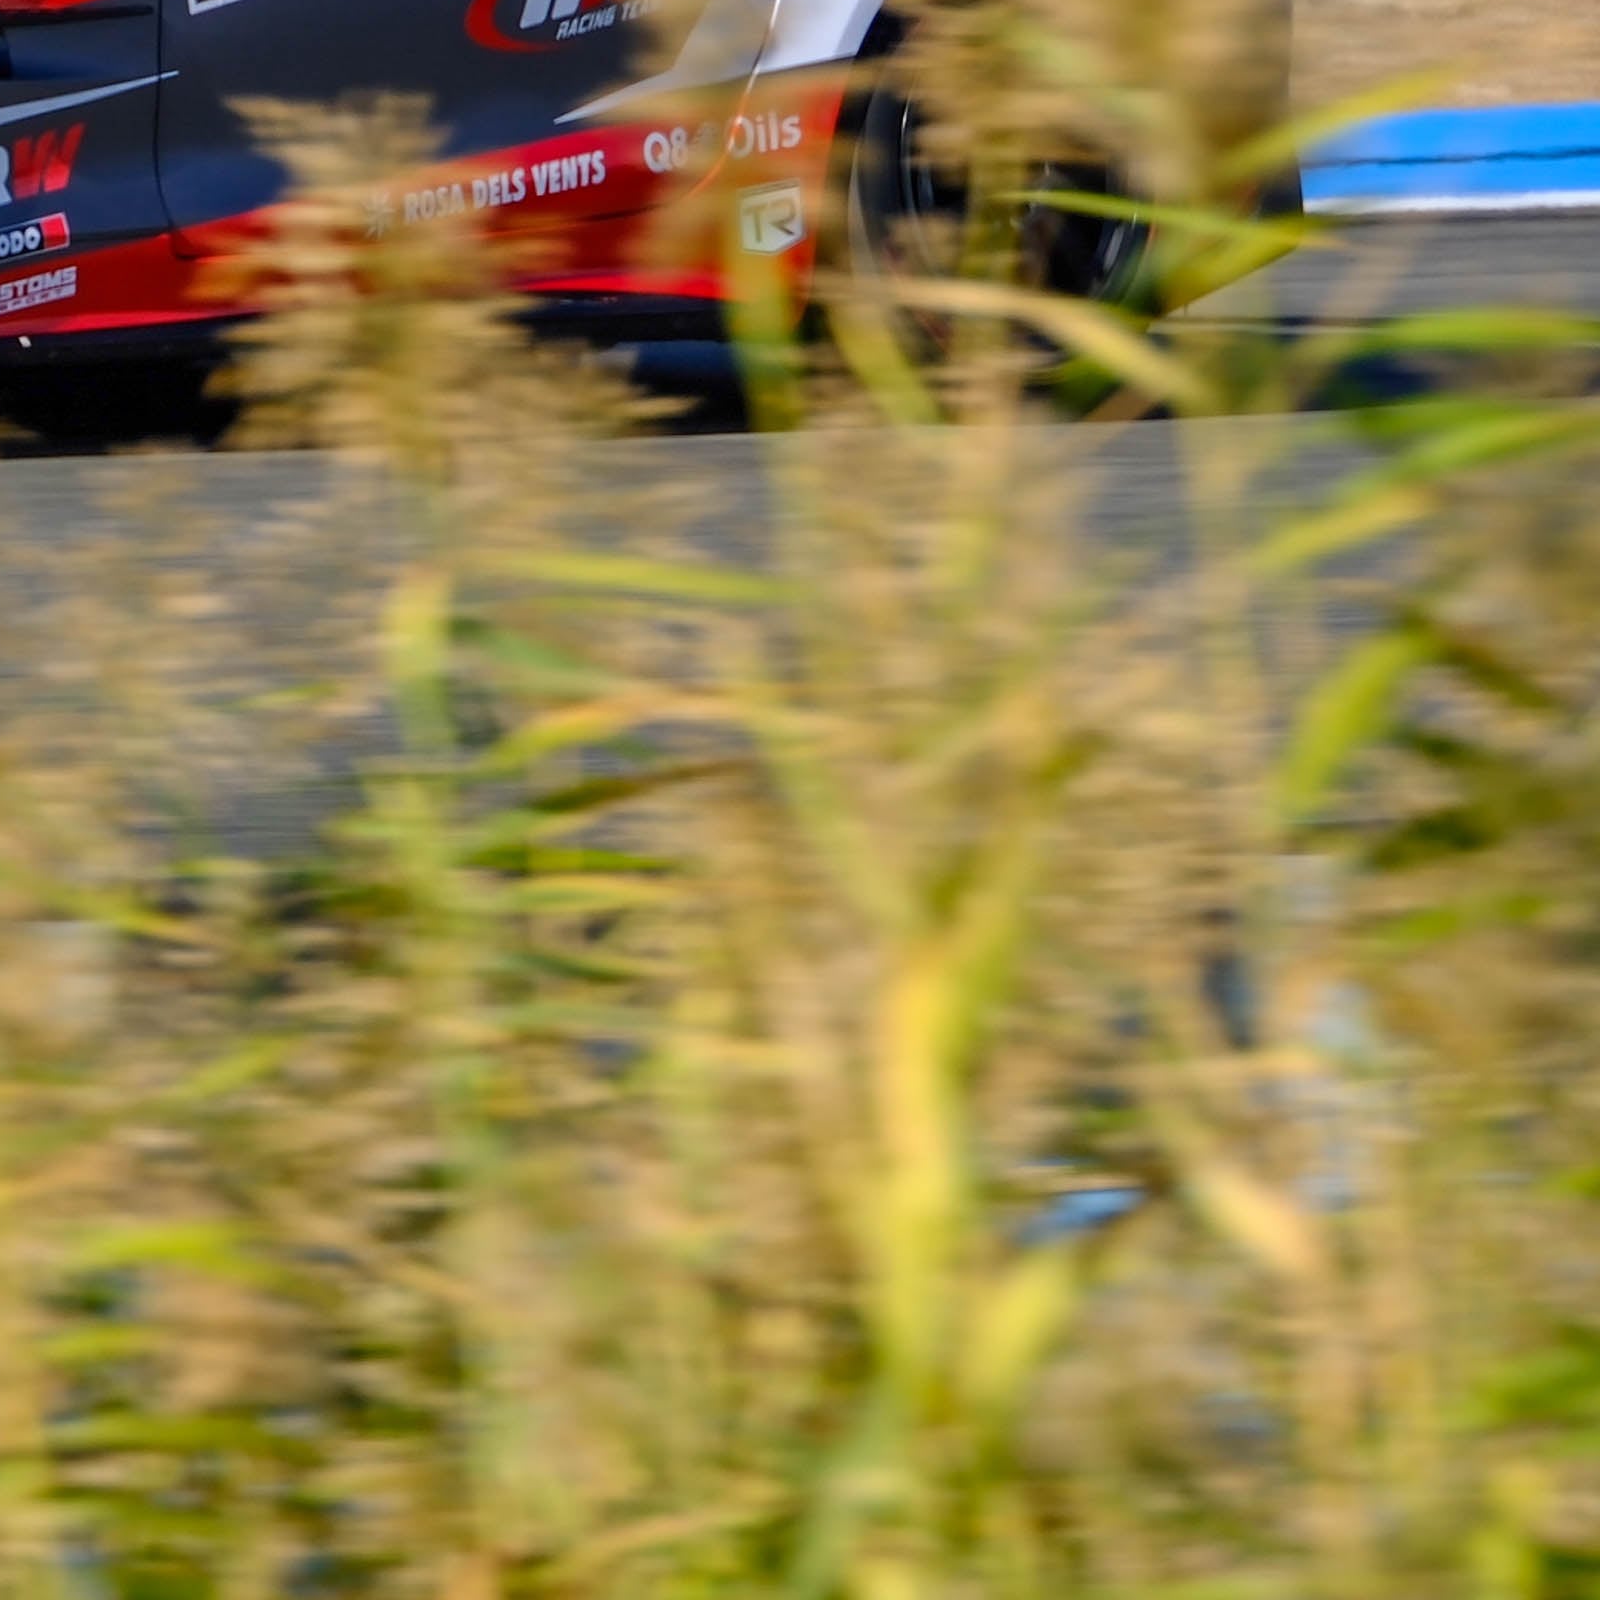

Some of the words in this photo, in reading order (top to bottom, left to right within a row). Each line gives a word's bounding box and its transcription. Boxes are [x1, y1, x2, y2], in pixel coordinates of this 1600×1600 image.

[555, 4, 618, 41] RACING
[725, 109, 802, 160] Oils
[403, 183, 466, 225] ROSA
[472, 167, 527, 210] DELS
[531, 150, 607, 197] VENTS
